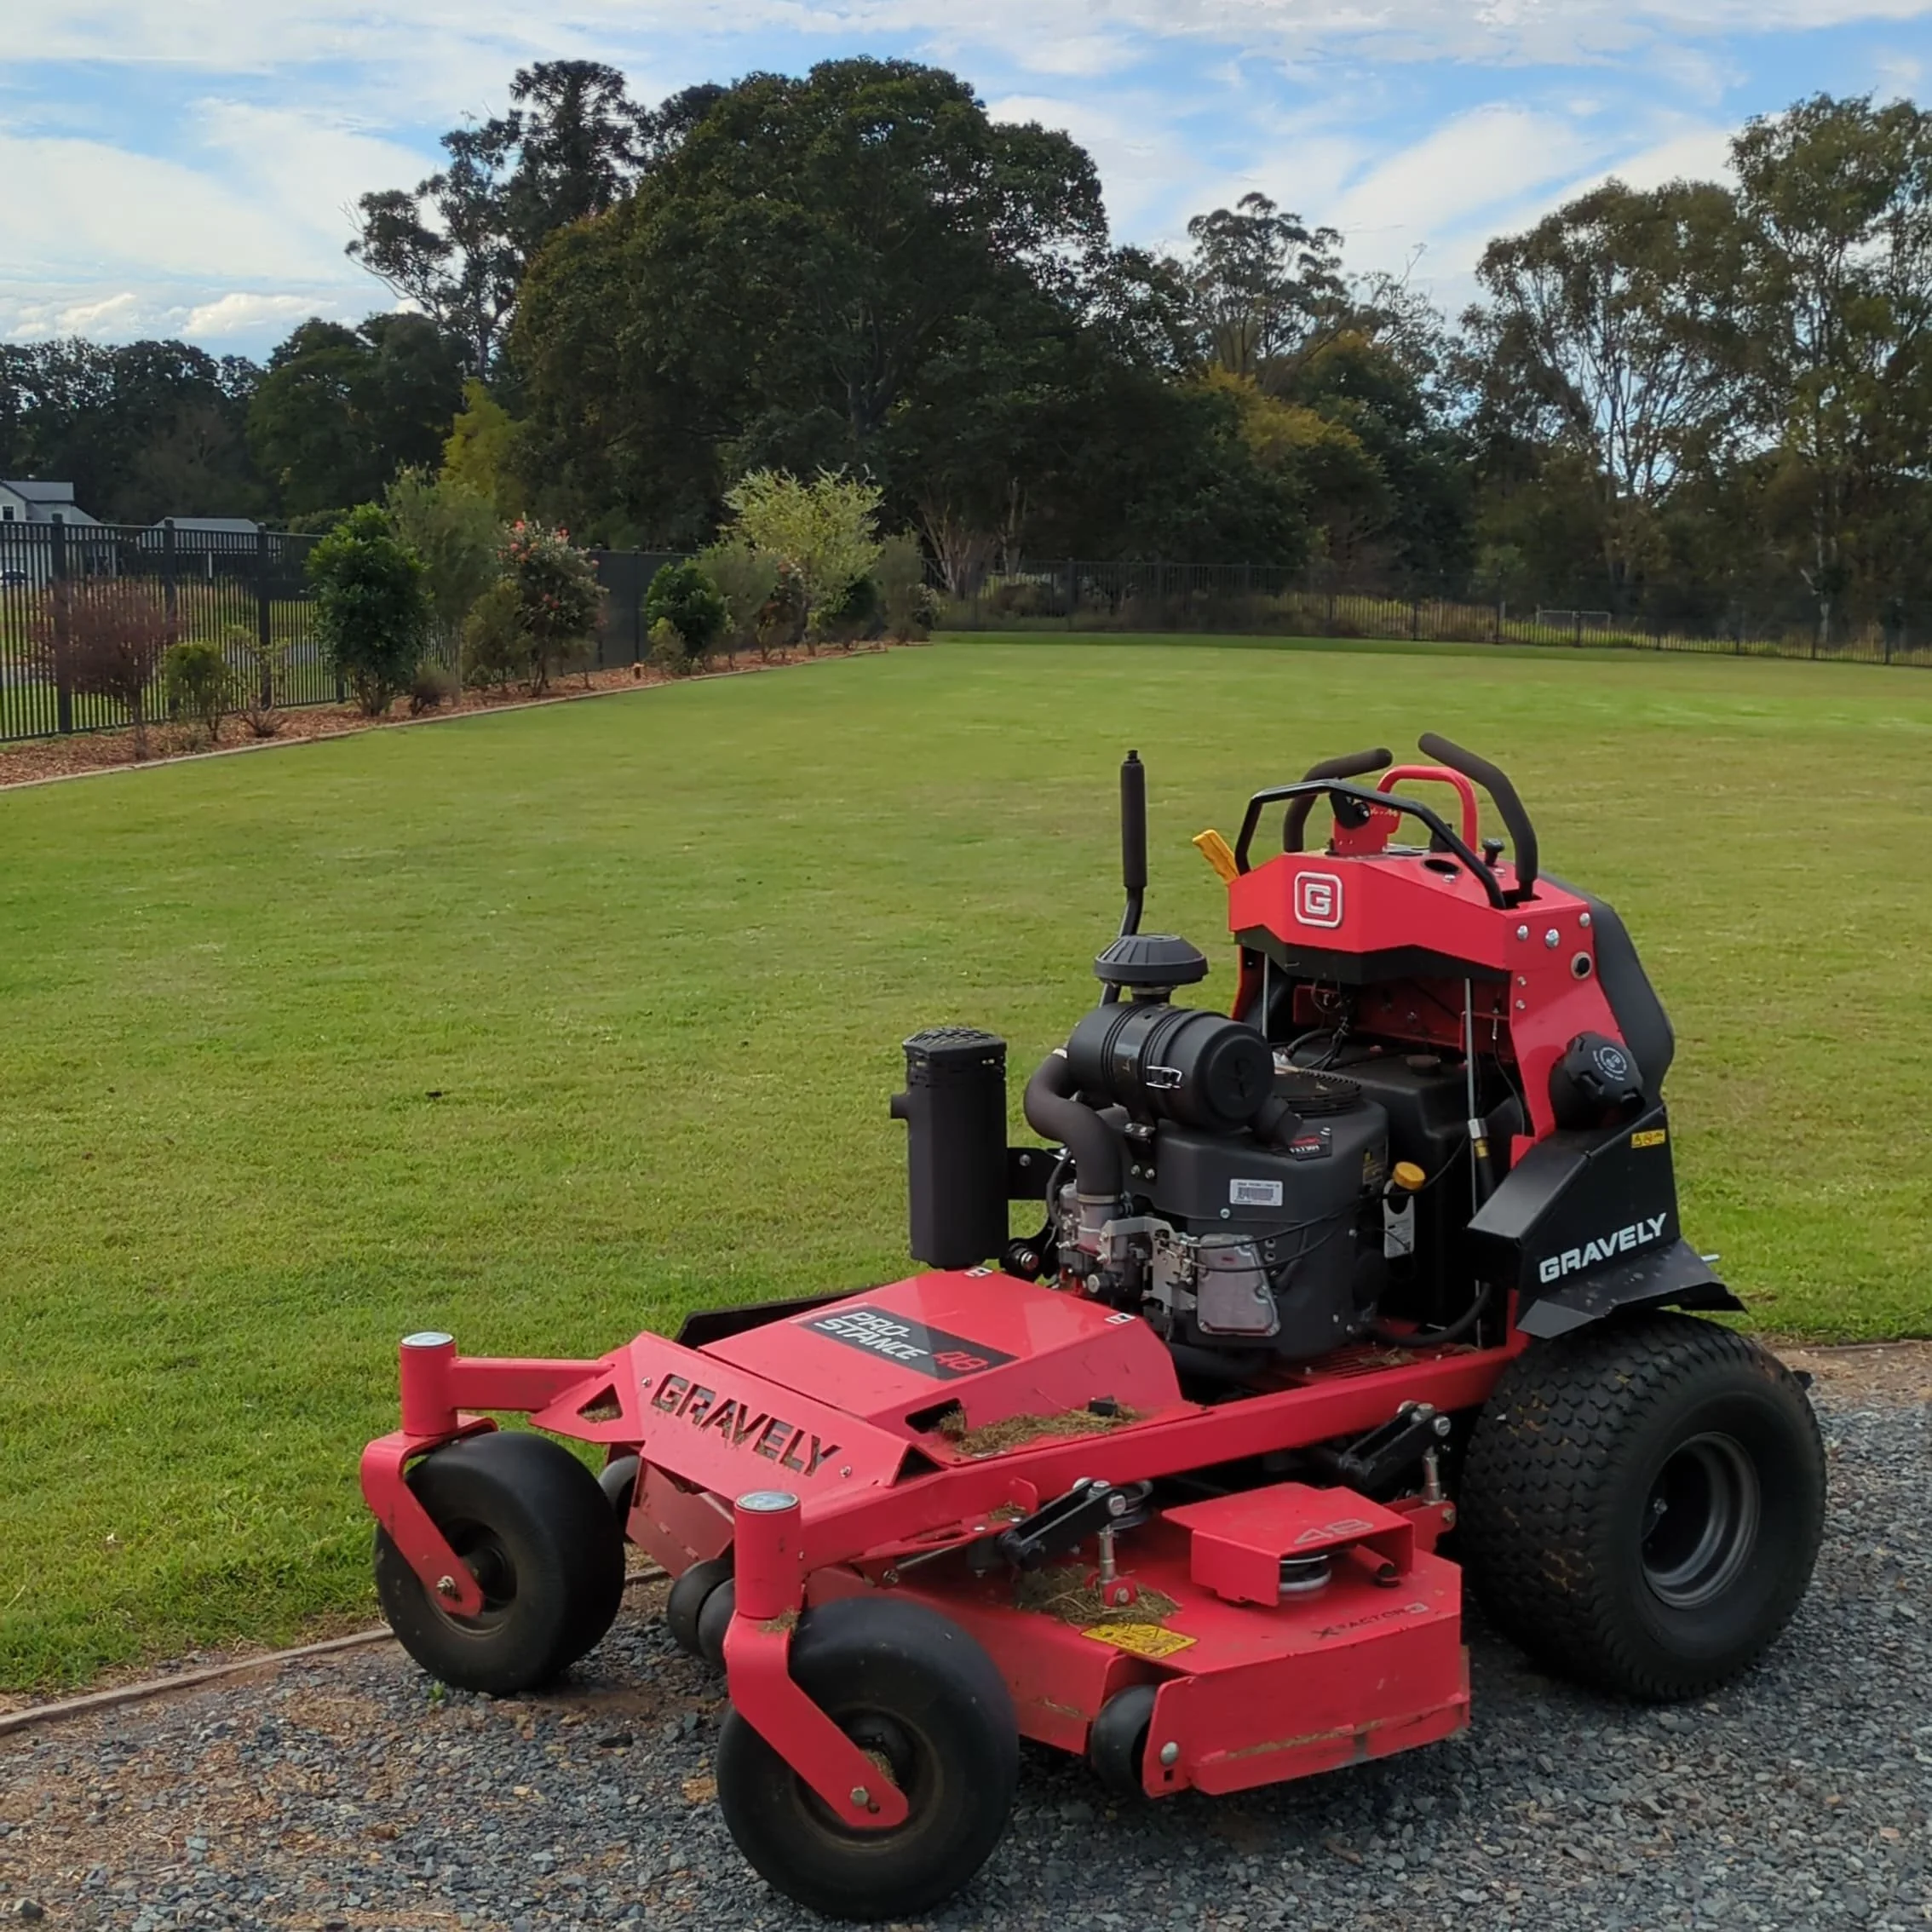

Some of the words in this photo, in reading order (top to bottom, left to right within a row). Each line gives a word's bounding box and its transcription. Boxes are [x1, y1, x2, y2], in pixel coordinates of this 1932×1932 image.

[1305, 883, 1331, 916] G
[1538, 1212, 1667, 1284] GRAVELY
[814, 1319, 929, 1360] STANCE
[933, 1351, 989, 1371] 48
[842, 1312, 911, 1338] PRO-
[650, 1373, 842, 1477] GRAVELY
[1294, 1518, 1374, 1544] 48
